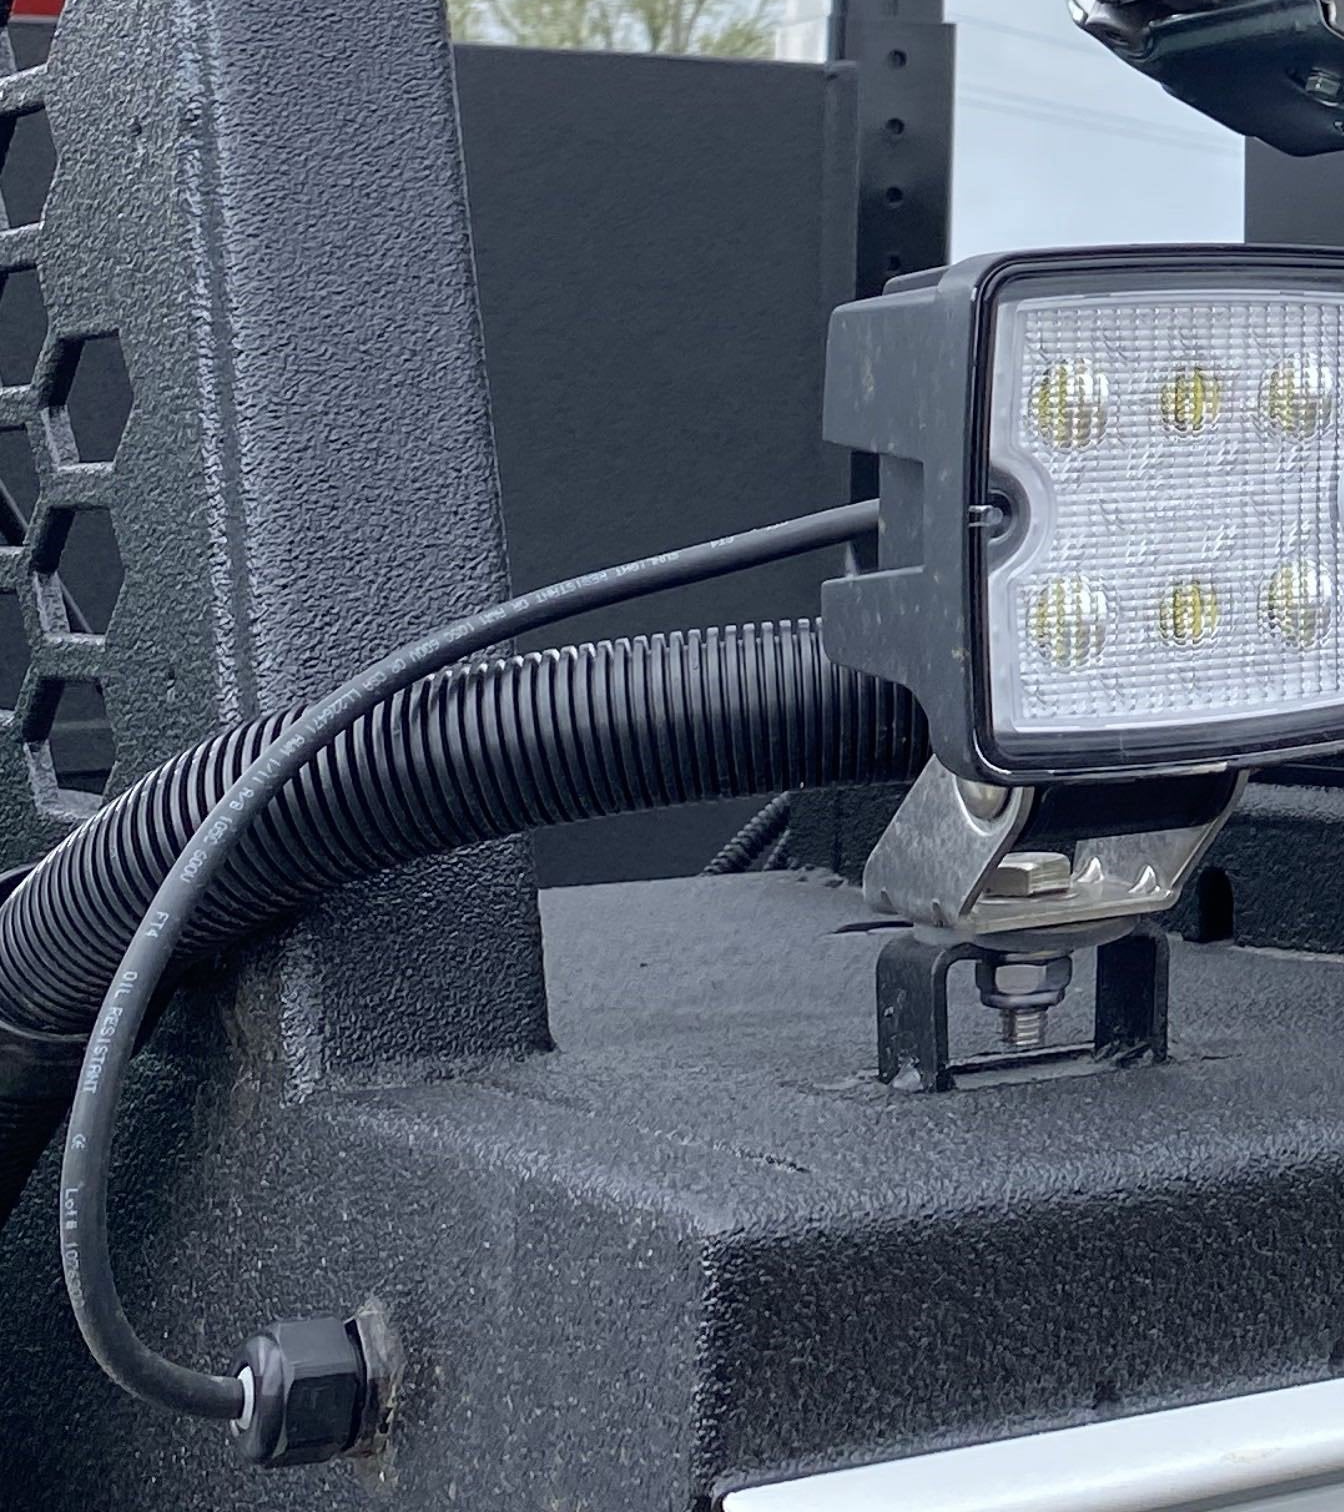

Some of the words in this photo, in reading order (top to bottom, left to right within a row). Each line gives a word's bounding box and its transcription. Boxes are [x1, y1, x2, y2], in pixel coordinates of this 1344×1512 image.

[537, 571, 608, 604] RESISTANT
[145, 911, 169, 938] FT4
[114, 970, 138, 999] OIL
[83, 1006, 123, 1095] RESISTANT
